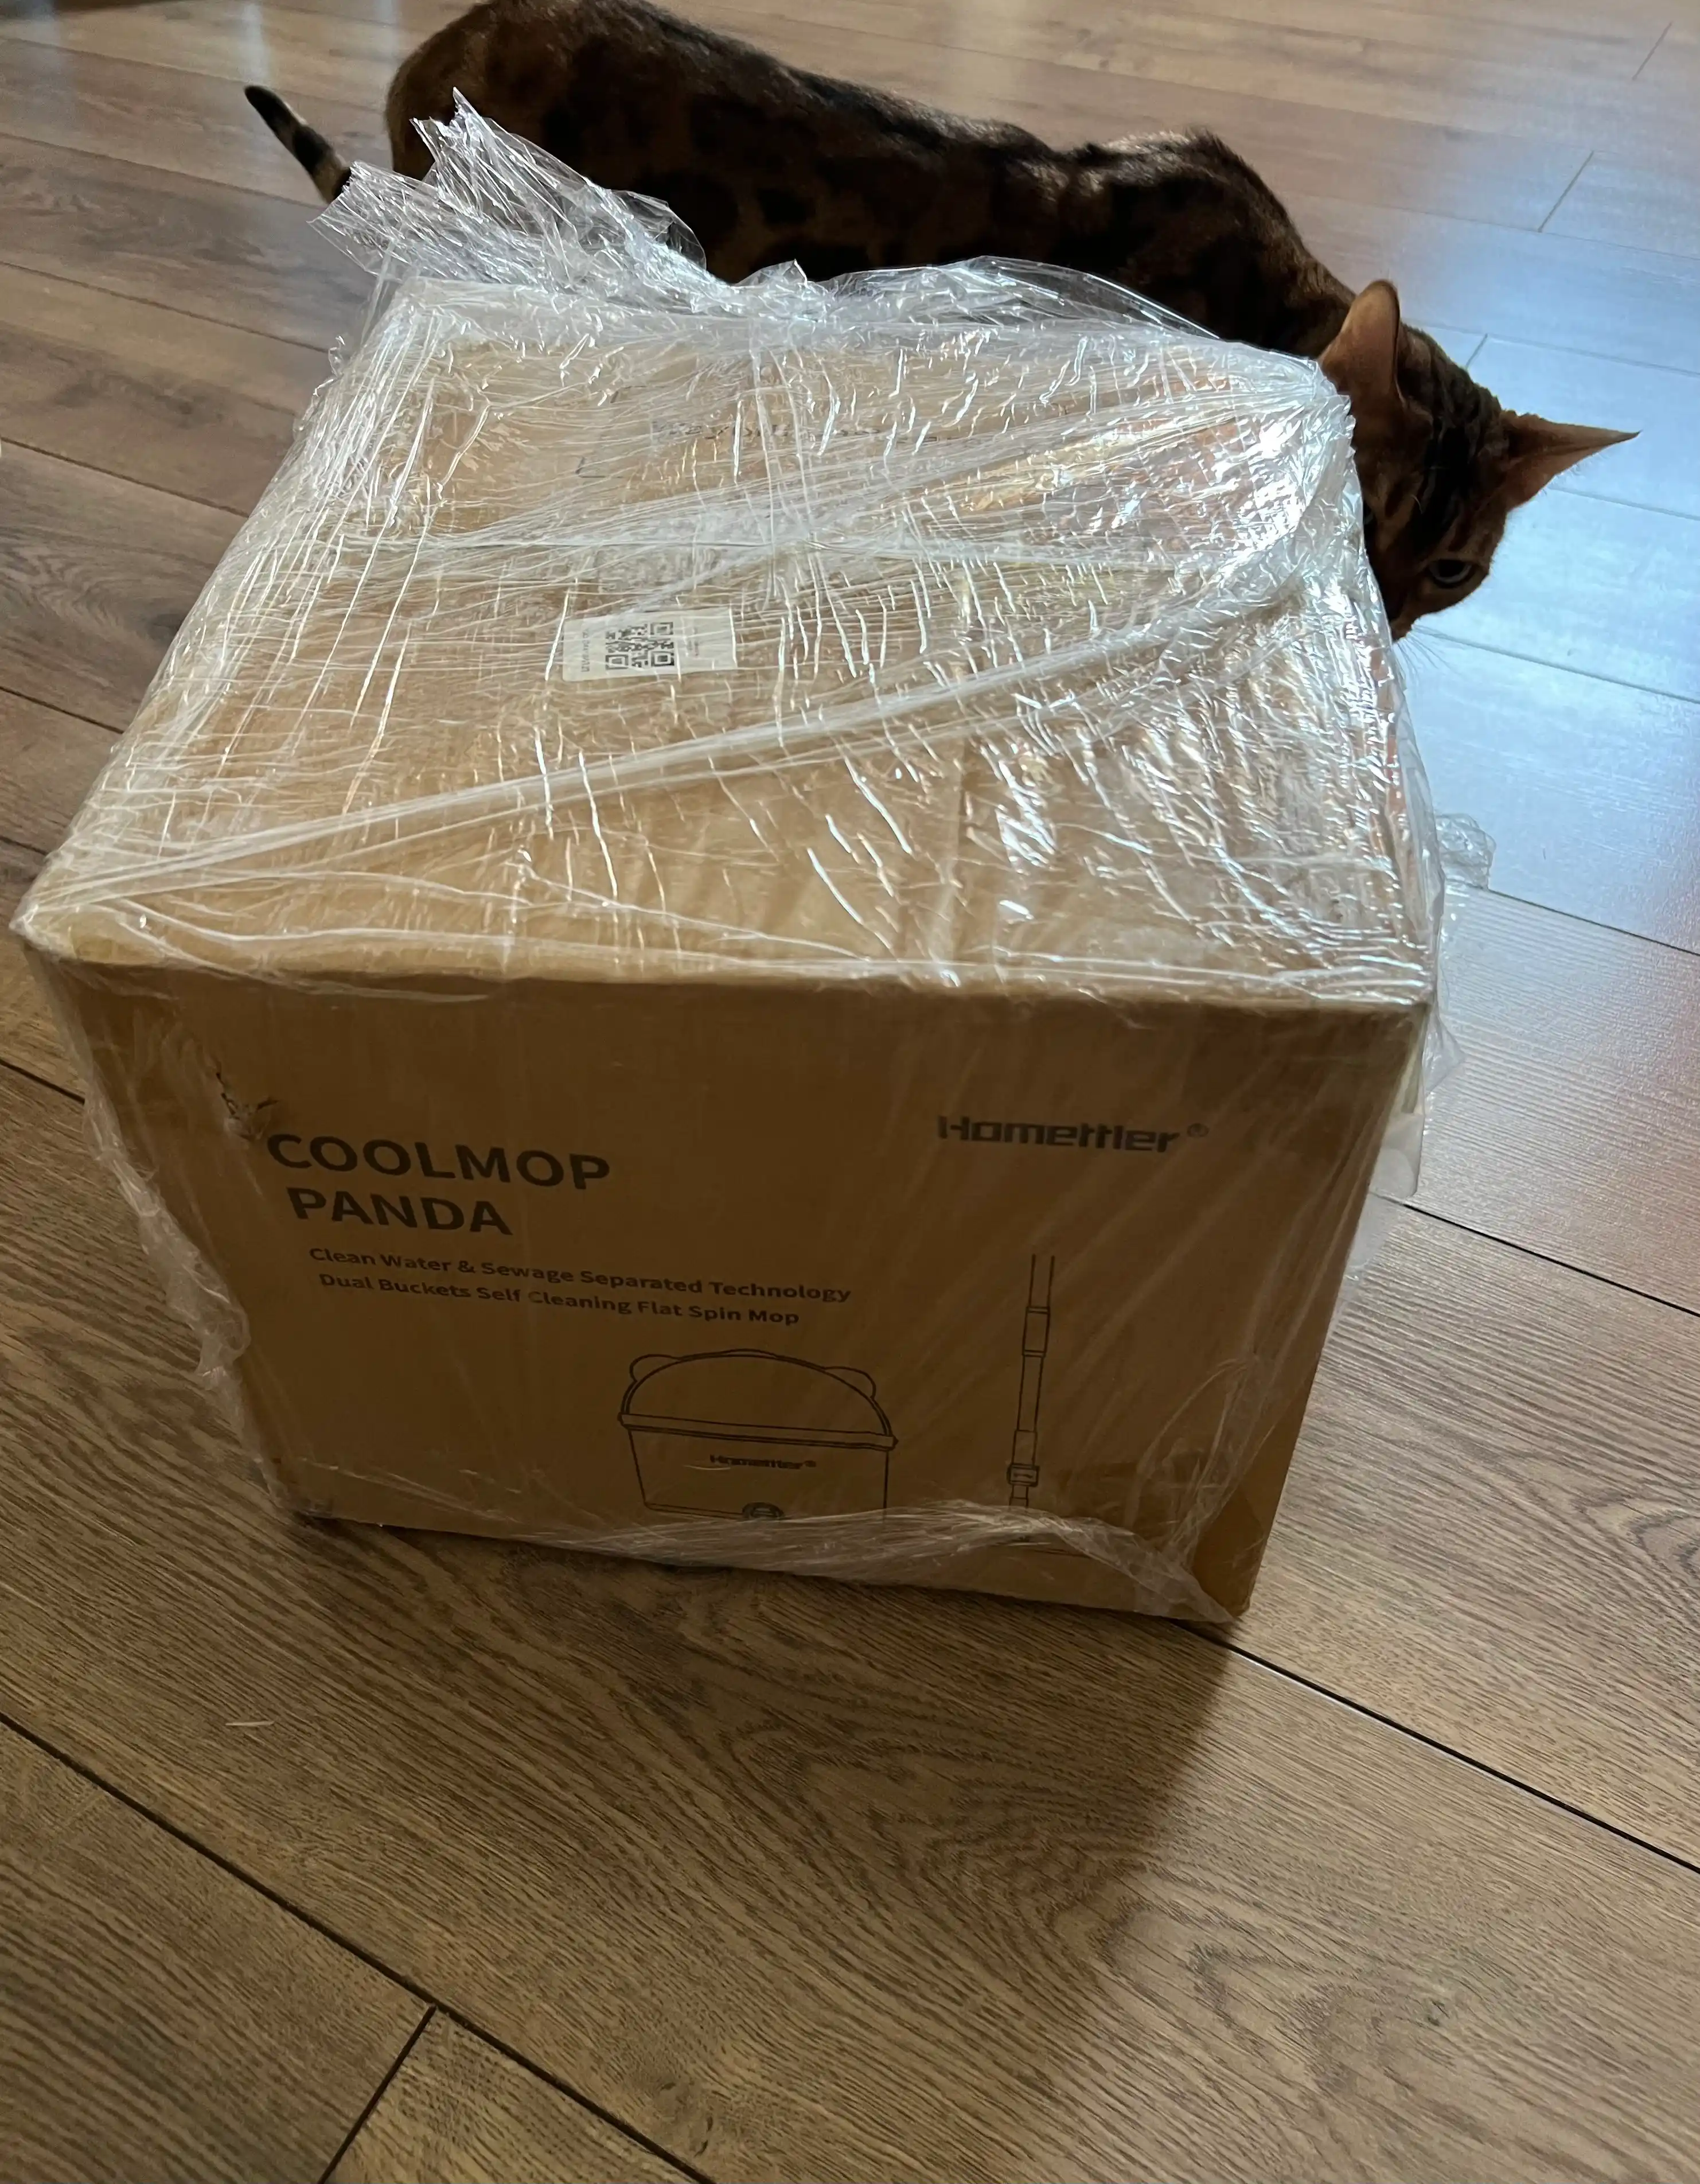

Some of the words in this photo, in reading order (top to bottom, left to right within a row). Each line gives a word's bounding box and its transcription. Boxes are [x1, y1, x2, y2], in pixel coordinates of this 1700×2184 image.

[267, 1133, 610, 1190] COOLMOP
[286, 1186, 513, 1235] PANDA
[309, 1247, 376, 1266] Clean
[380, 1253, 452, 1272] Water
[457, 1260, 476, 1274] &
[481, 1262, 574, 1283] Sewage
[580, 1270, 703, 1294] Separated
[708, 1281, 852, 1303] Technology
[319, 1273, 374, 1290] Dual
[378, 1278, 471, 1298] Buckets
[476, 1286, 521, 1302] Self
[528, 1290, 632, 1315] Cleaning
[637, 1300, 684, 1317] Flat
[688, 1305, 742, 1322] Spin
[748, 1309, 800, 1326] Mop
